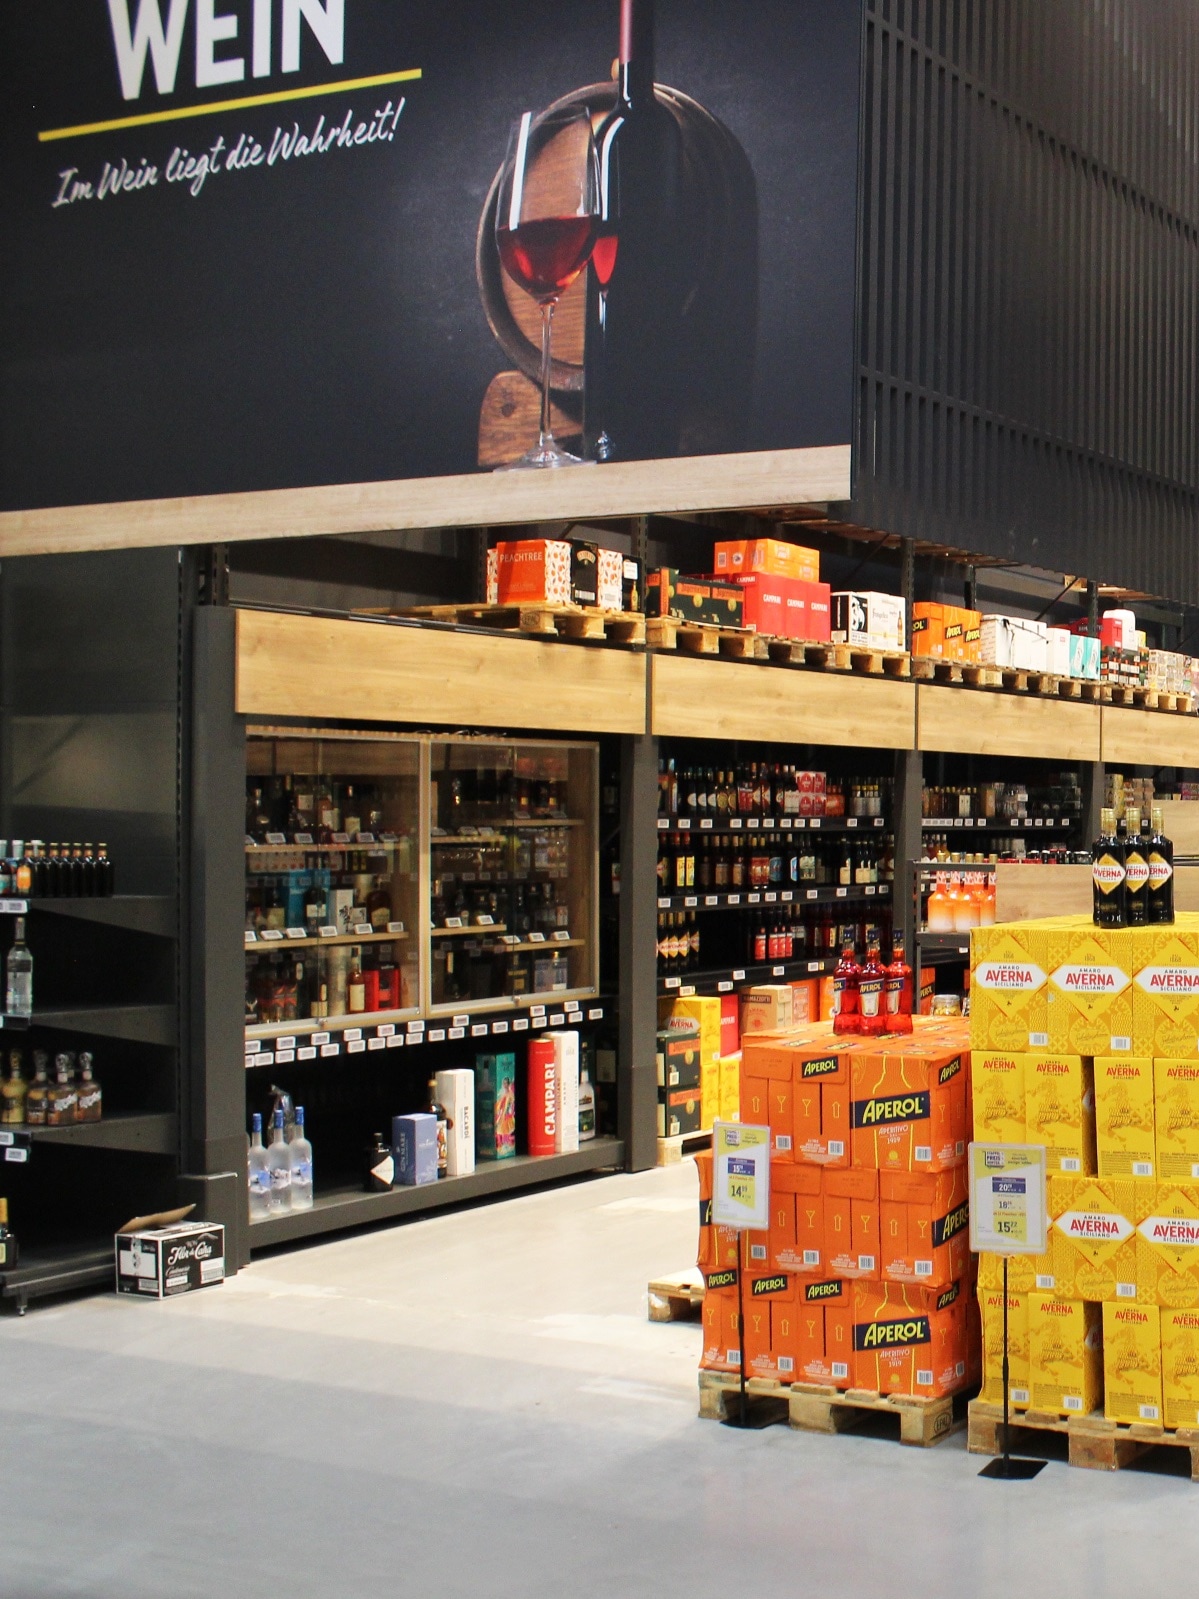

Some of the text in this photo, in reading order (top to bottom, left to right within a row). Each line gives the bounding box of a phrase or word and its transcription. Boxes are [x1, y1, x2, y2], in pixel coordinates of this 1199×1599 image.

[107, 0, 345, 100] WEIN
[51, 97, 405, 208] Im Wein liegt die Wahrheit!
[500, 552, 542, 563] PEACHTREE
[763, 593, 781, 605] CAMPARI
[787, 598, 805, 609] CAMPARI
[985, 970, 1033, 983] AVERNA
[1065, 973, 1115, 986] AVERNA
[804, 1059, 836, 1076] APEROL
[983, 1060, 1017, 1070] AVERNA
[1036, 1063, 1069, 1073] AVERNA
[1106, 1067, 1141, 1077] AVERNA
[544, 1063, 555, 1136] CAMPARI
[862, 1097, 923, 1124] APEROL
[878, 1124, 909, 1135] APERITIVO
[943, 1203, 970, 1241] APERO
[1070, 1219, 1120, 1234] AVERNA
[708, 1272, 735, 1288] APEROL
[754, 1277, 786, 1294] APEROL
[807, 1282, 840, 1299] APEROL
[988, 1297, 1020, 1308] AVENA
[1041, 1303, 1073, 1314] AVERNA
[1114, 1310, 1149, 1322] AVERNA
[863, 1321, 925, 1347] APEROL
[879, 1348, 910, 1359] APERITIVO
